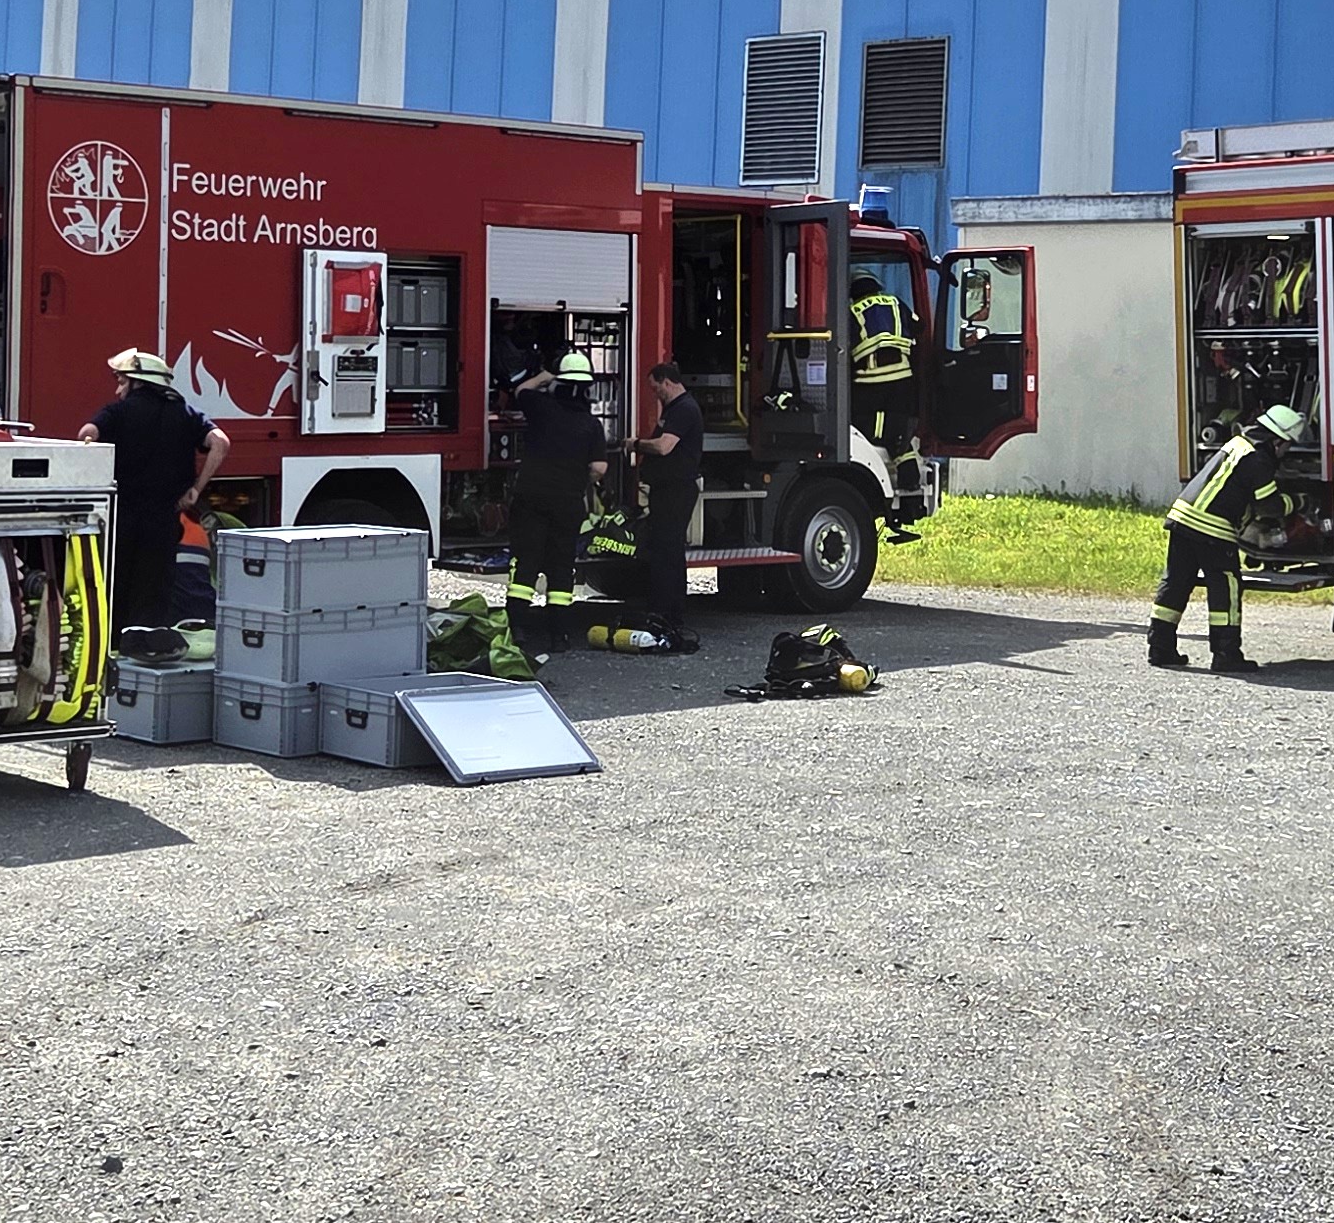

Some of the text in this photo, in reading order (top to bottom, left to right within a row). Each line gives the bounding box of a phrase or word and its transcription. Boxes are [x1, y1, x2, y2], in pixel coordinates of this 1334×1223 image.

[171, 162, 328, 202] Feuerwehr
[170, 209, 378, 250] Stadt Arnsberg
